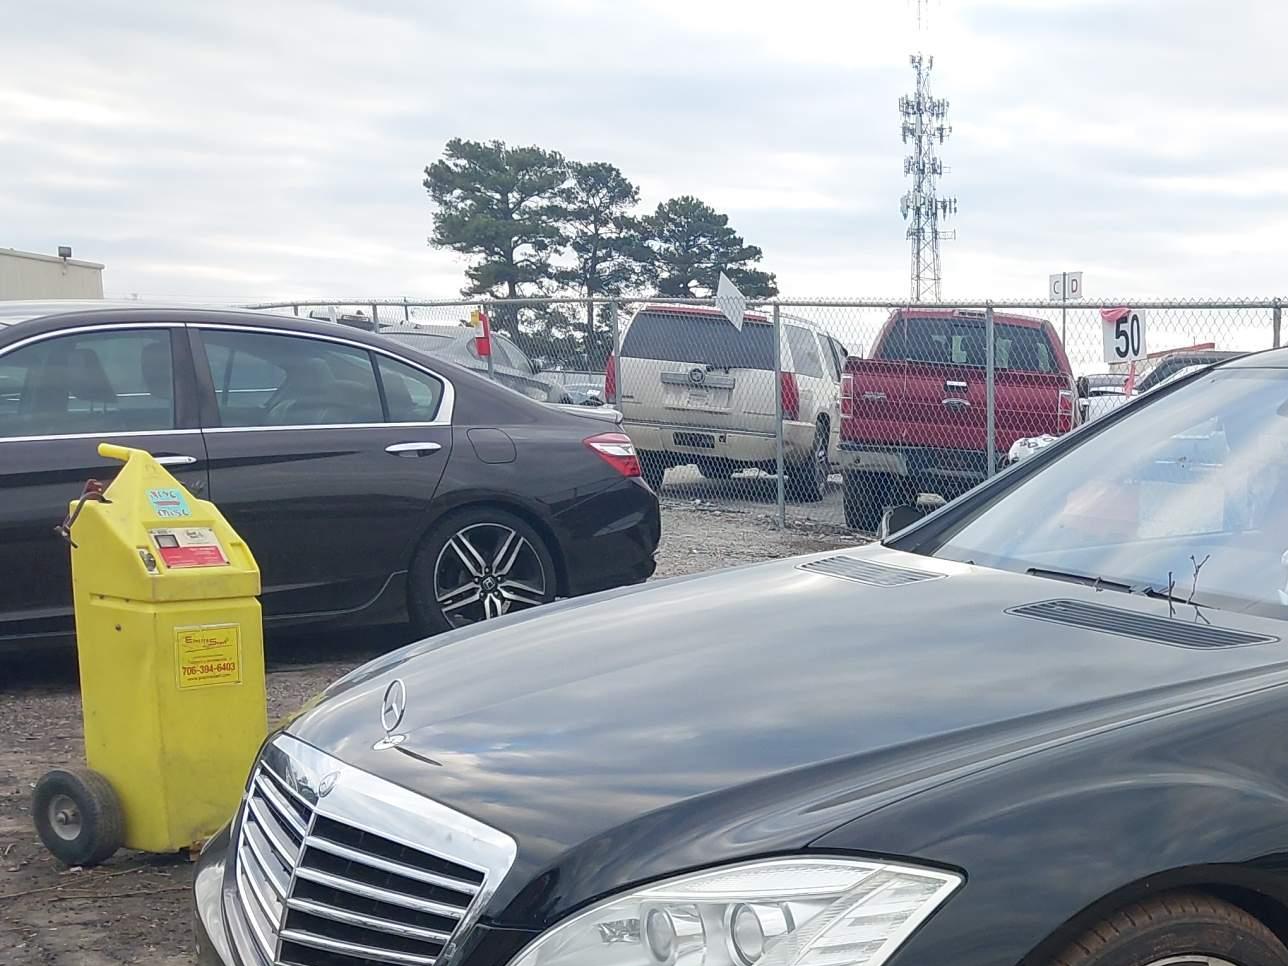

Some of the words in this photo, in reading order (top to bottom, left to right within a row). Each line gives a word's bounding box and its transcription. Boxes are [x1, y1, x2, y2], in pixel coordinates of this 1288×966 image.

[1053, 280, 1060, 294] C
[1071, 278, 1078, 293] D
[1115, 313, 1140, 358] 50
